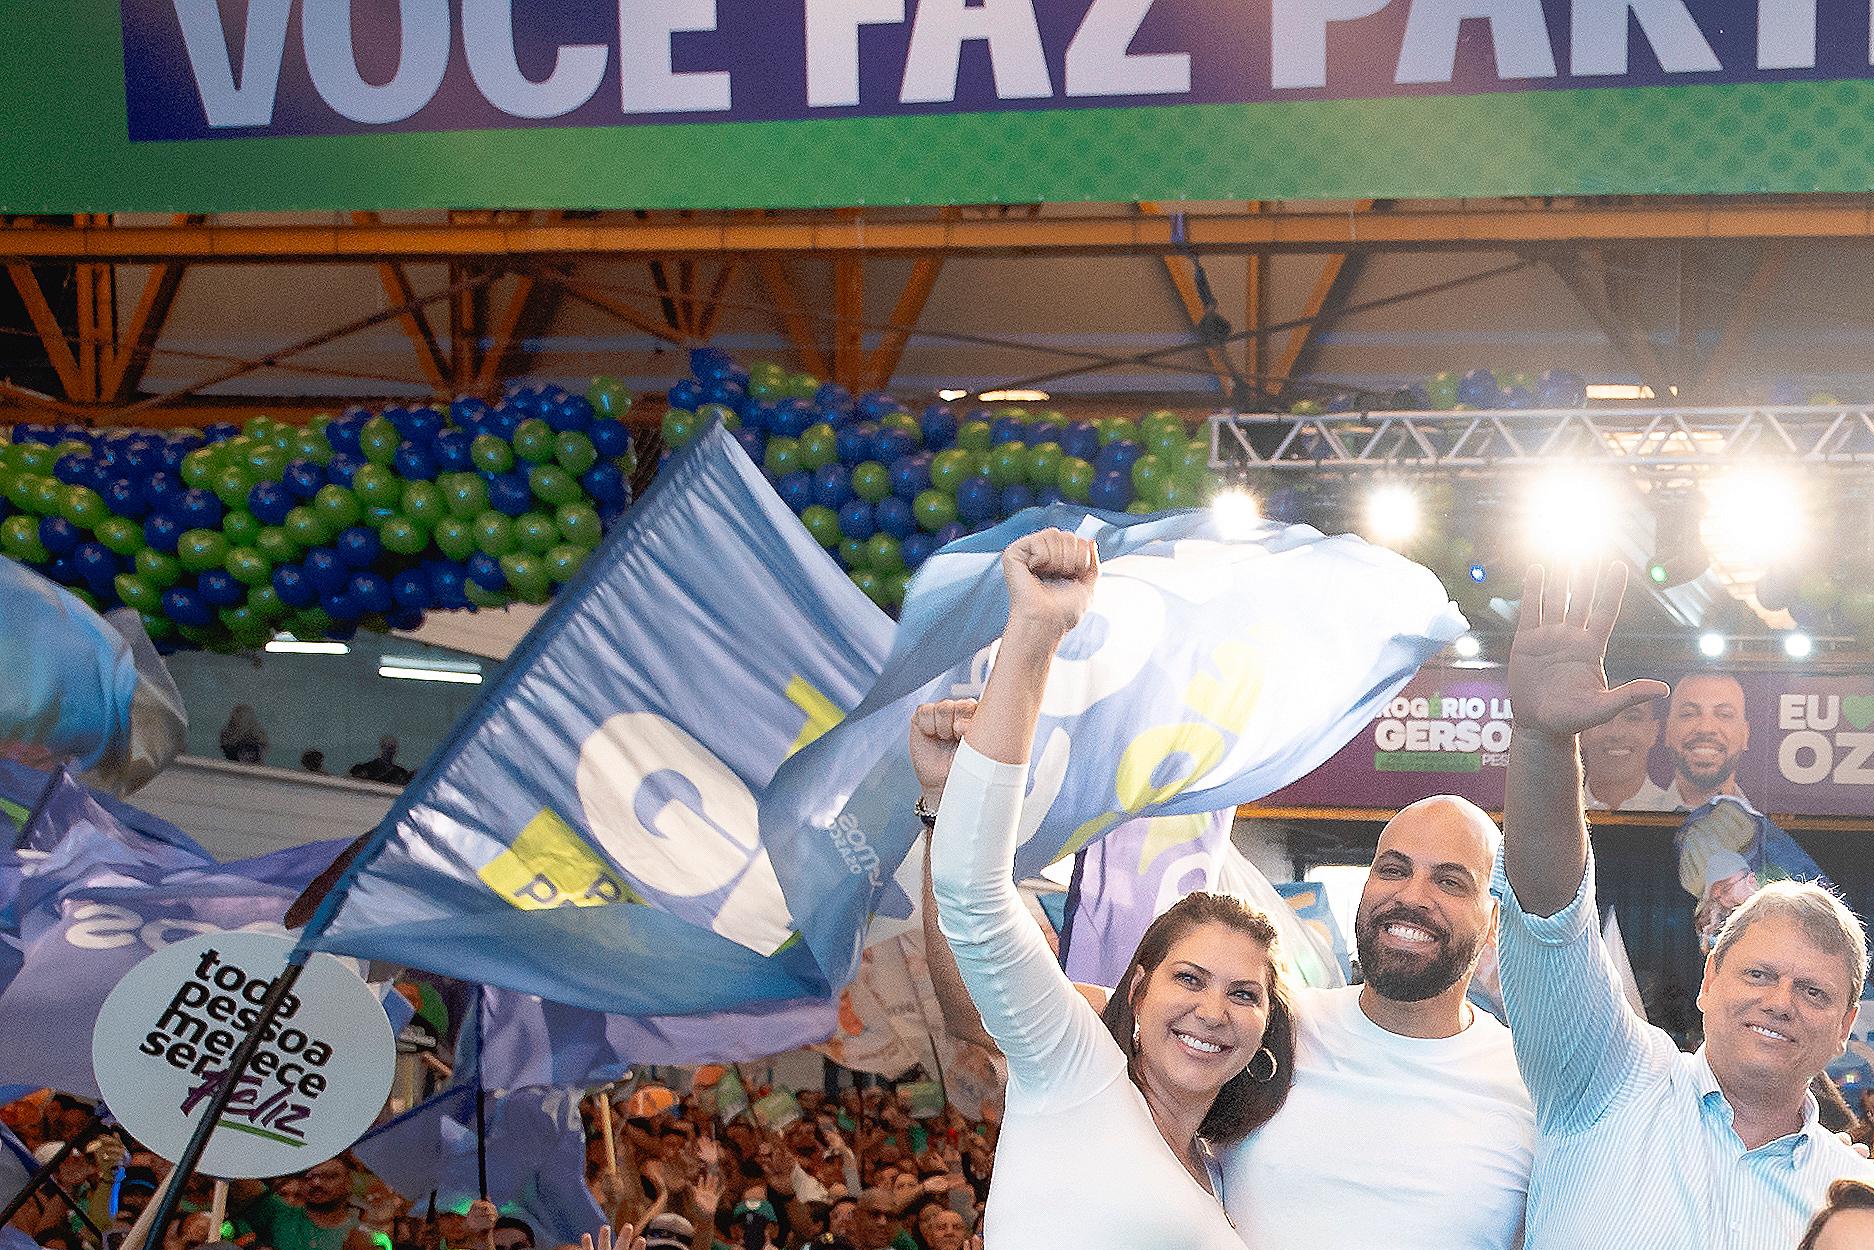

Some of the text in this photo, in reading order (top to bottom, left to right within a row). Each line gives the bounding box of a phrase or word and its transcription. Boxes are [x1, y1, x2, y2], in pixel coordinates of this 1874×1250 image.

[1778, 693, 1839, 731] EU
[138, 1030, 221, 1077] ser
[156, 1008, 328, 1100] meece
